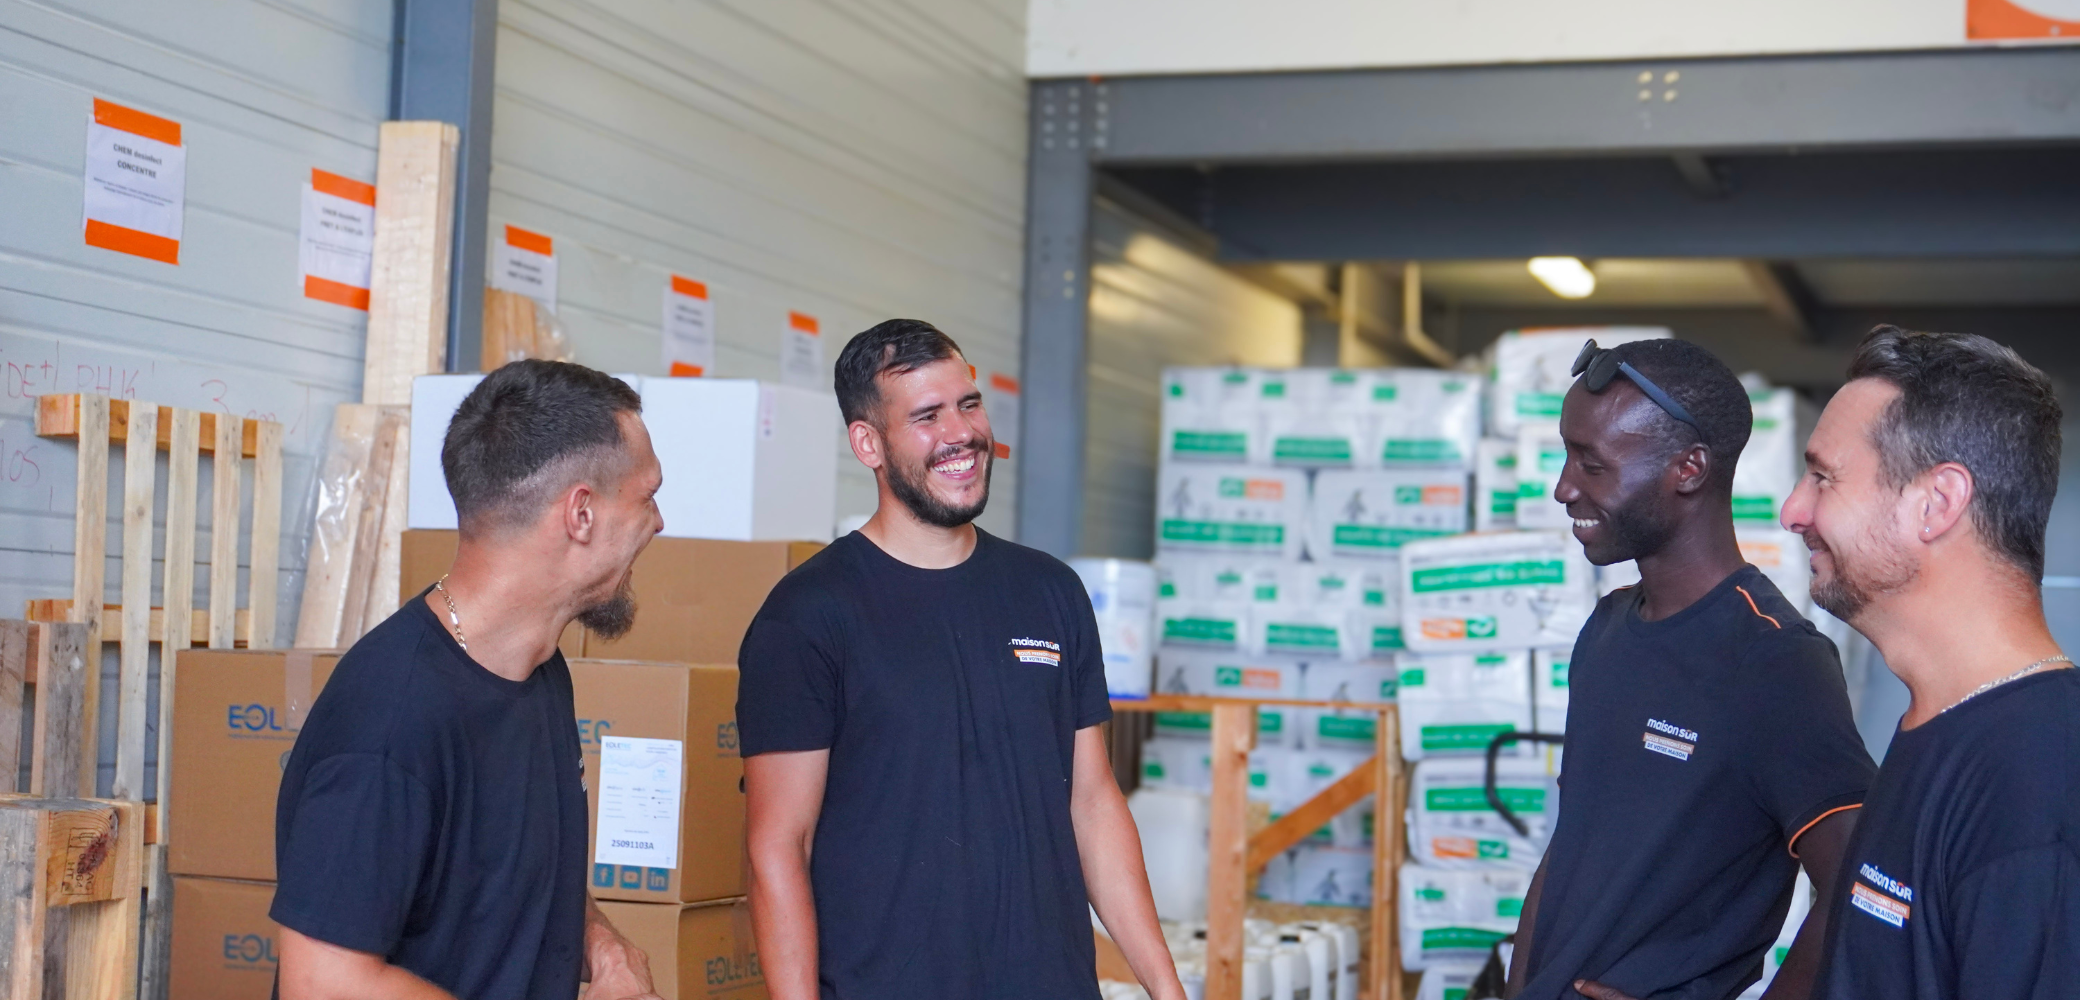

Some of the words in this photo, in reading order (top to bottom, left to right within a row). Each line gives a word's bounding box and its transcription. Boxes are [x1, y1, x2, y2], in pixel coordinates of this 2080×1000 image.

[113, 143, 132, 156] CHEM
[117, 160, 156, 179] CONCENTRE
[611, 839, 654, 850] 25091103A
